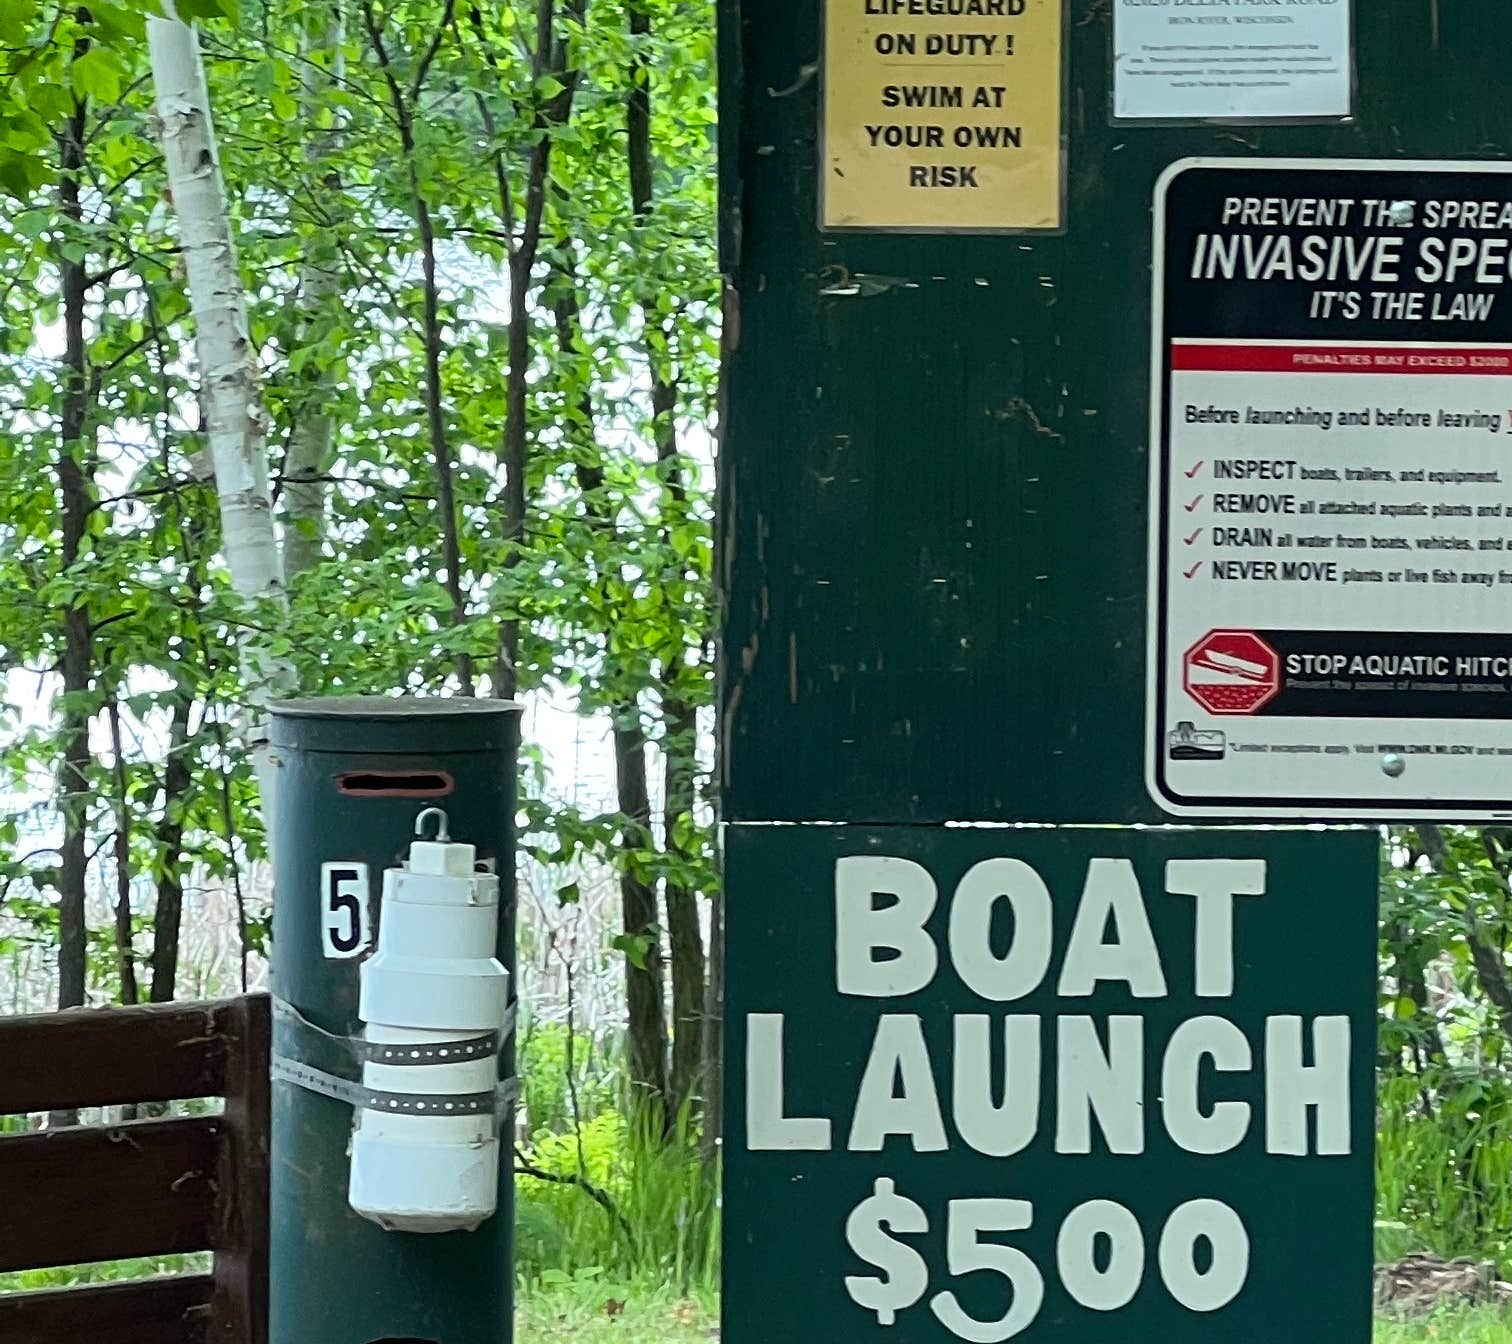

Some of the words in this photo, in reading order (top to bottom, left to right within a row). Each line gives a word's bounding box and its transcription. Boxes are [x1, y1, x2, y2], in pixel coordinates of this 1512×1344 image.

[875, 34, 915, 56] ON
[882, 86, 962, 108] SWIM
[972, 86, 1006, 108] AT
[864, 125, 944, 147] YOUR
[953, 126, 1021, 148] OWN
[909, 166, 979, 188] RISK
[1222, 197, 1353, 227] PREVENT
[1362, 199, 1416, 229] THE
[1191, 233, 1403, 282] INVASIVE
[1310, 291, 1361, 320] IT'S
[1371, 291, 1425, 320] THE
[1432, 293, 1494, 322] LAW
[1292, 353, 1372, 365] PENALTIES
[1374, 355, 1405, 366] MAY
[1408, 355, 1466, 367] EXCEED
[1184, 404, 1240, 425] Before
[1245, 406, 1332, 431] launching
[1337, 407, 1371, 427] and
[1375, 408, 1432, 429] before
[1437, 409, 1501, 433] leaving
[1213, 460, 1297, 481] INSPECT
[1400, 468, 1424, 482] and
[1213, 494, 1295, 514] REMOVE
[1300, 501, 1315, 514] all
[1477, 503, 1502, 517] and
[1213, 527, 1272, 547] DRAIN
[1278, 534, 1293, 547] all
[1297, 536, 1333, 548] water
[1337, 535, 1367, 548] from
[1478, 537, 1503, 550] and
[1212, 561, 1277, 580] NEVER
[1282, 562, 1337, 581] MOVE
[1342, 568, 1383, 584] plants
[1388, 571, 1401, 582] or
[1404, 569, 1428, 582] live
[1432, 570, 1457, 583] fish
[1461, 572, 1495, 587] away
[1286, 654, 1346, 675] STOP
[1349, 655, 1449, 677] AQUATIC
[835, 856, 1267, 1002] BOAT
[746, 1013, 1352, 1157] LAUNCH
[843, 1177, 1251, 1344] $500
